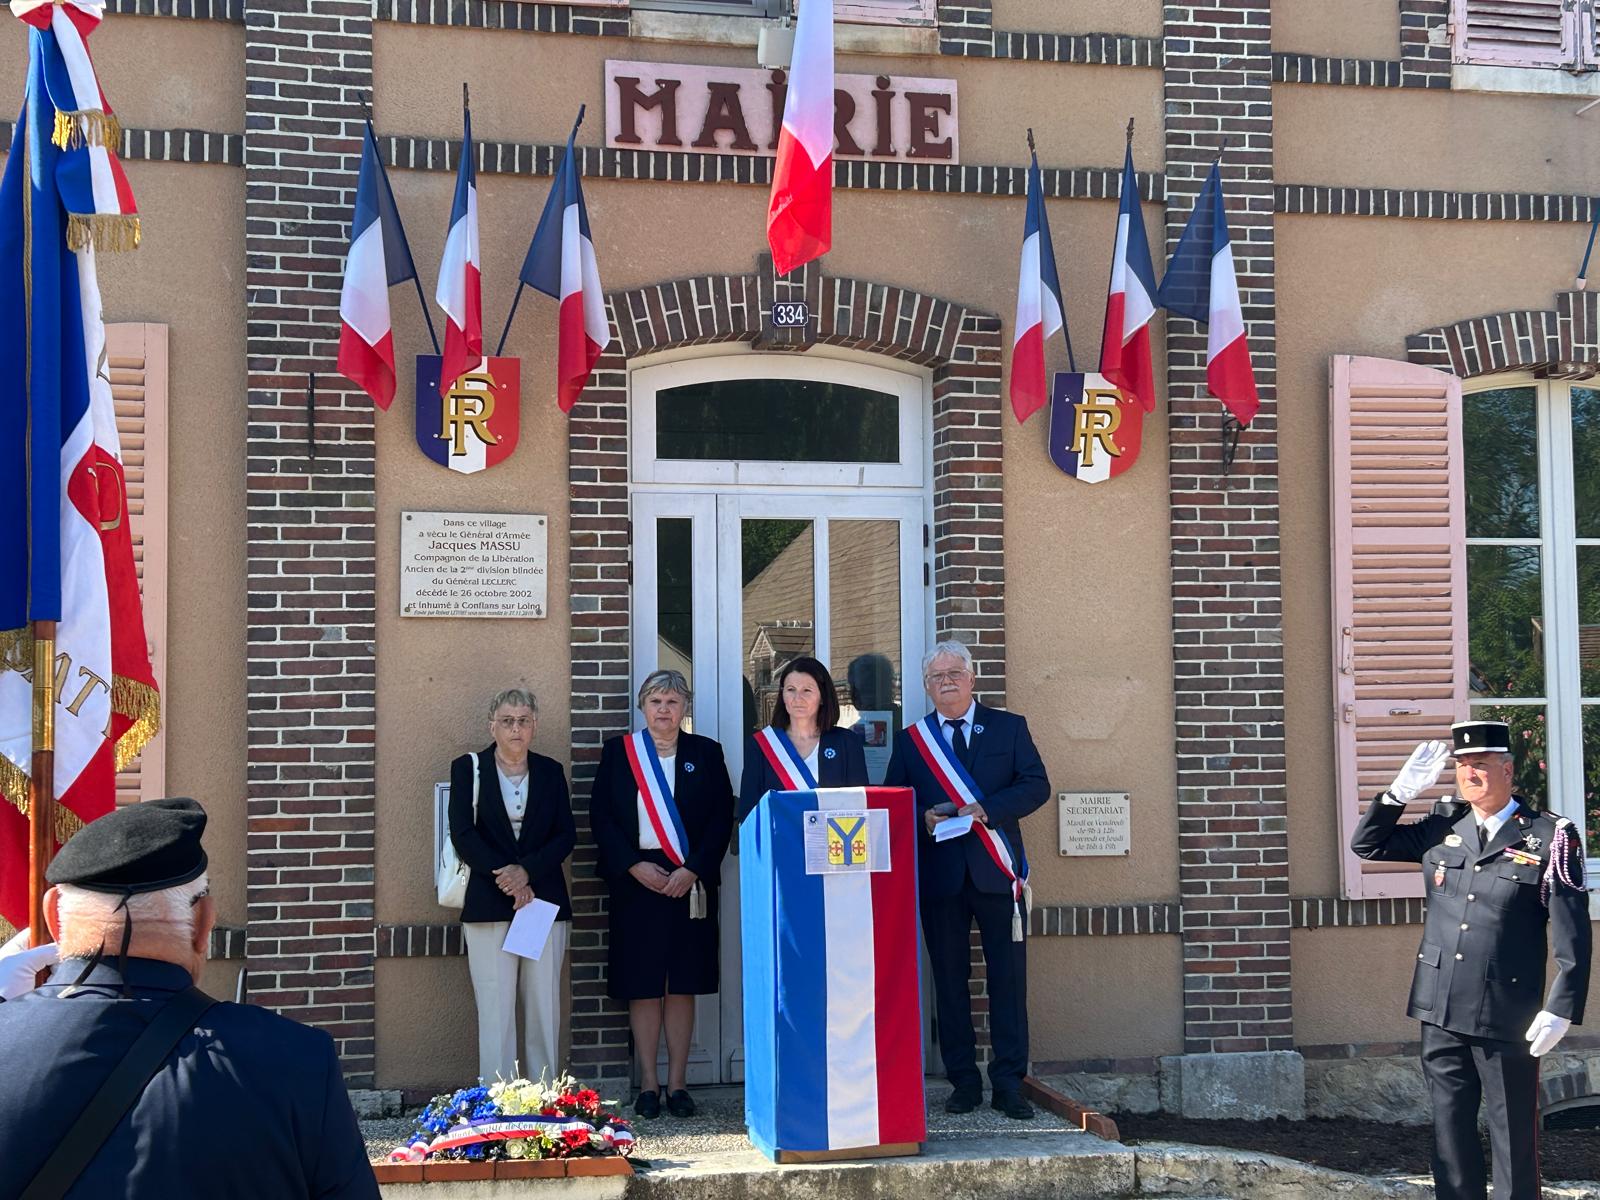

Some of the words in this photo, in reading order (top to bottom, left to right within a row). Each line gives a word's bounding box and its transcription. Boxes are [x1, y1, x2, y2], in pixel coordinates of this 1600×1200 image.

[777, 305, 804, 324] 334
[443, 519, 465, 527] Dans
[480, 520, 507, 529] village
[459, 531, 493, 539] Général
[495, 532, 531, 540] d'Armée
[428, 540, 477, 552] Jacques
[480, 541, 521, 551] MASSU
[414, 553, 466, 563] Compagnon
[468, 554, 479, 562] de
[492, 555, 535, 563] Libération
[404, 565, 434, 573] Ancien
[436, 565, 448, 573] de
[450, 565, 458, 573] la
[476, 566, 510, 574] division
[512, 566, 544, 574] blindée
[415, 589, 448, 597] décédé
[450, 589, 459, 597] le
[460, 589, 472, 597] 26
[474, 590, 508, 598] octobre
[509, 590, 532, 598] 2002
[418, 601, 451, 609] inhumé
[517, 603, 541, 611] Loing
[1080, 796, 1111, 805] MAIRIE
[1066, 807, 1124, 815] SECRETARIAT
